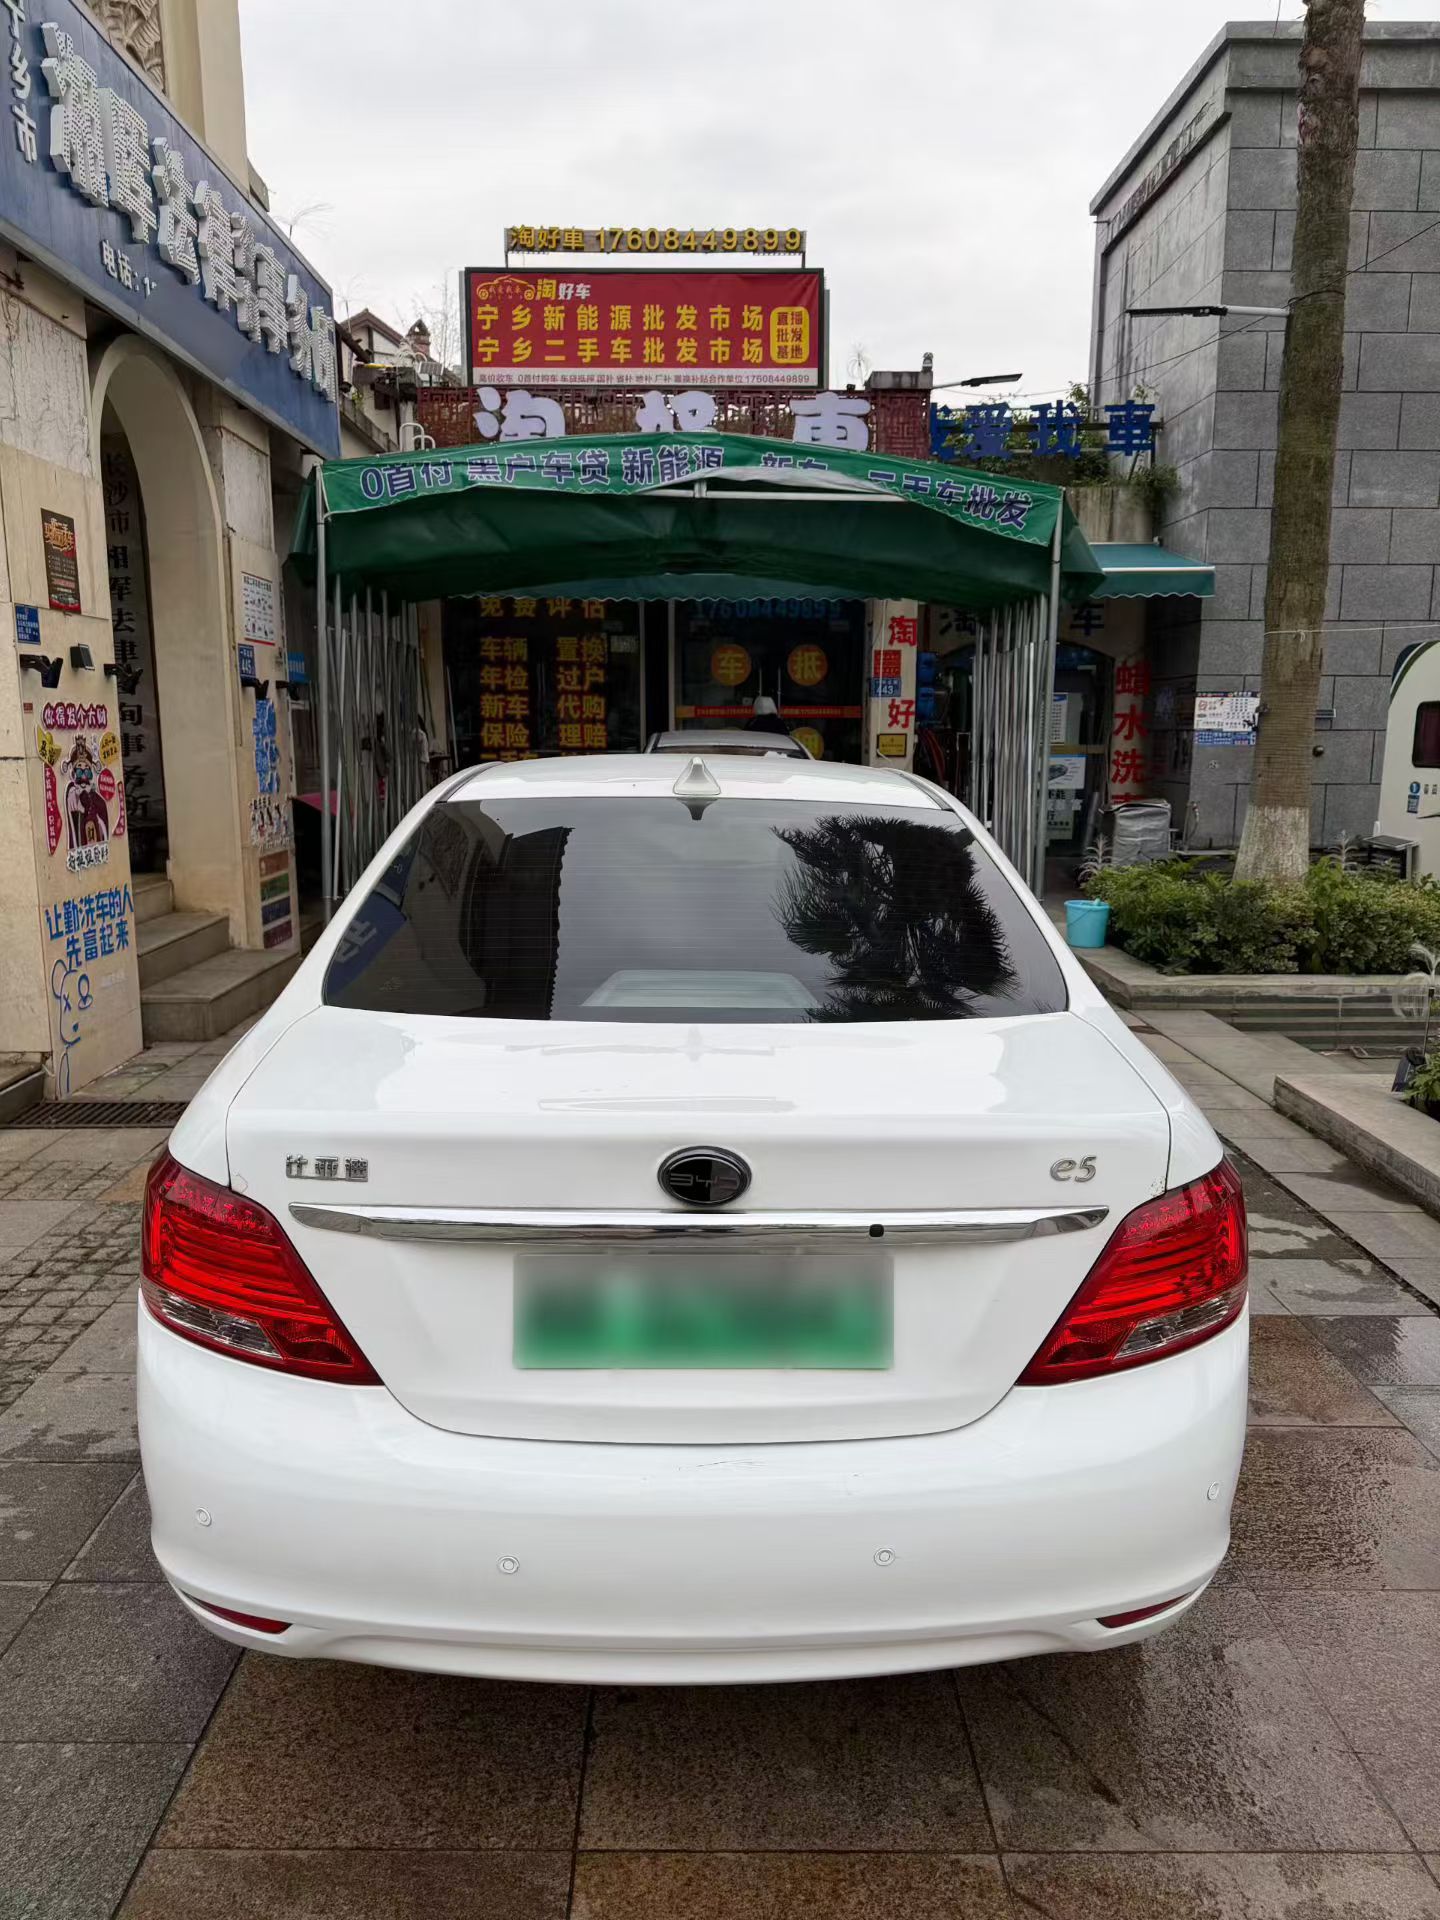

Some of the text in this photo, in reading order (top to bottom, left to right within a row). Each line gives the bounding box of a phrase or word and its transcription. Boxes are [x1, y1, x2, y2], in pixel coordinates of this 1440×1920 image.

[510, 225, 801, 251] 淘好車 17608449899
[536, 279, 591, 300] 淘好车
[477, 304, 764, 331] 宁乡新能源批发市场
[477, 337, 764, 364] 宁乡二手车批发市场
[745, 374, 810, 384] 17608449899
[360, 459, 453, 500] 0首付
[467, 450, 609, 486] 黑户车贷
[621, 444, 724, 484] 新能源
[480, 598, 605, 618] 免费评估
[481, 635, 607, 663] 车辆 置换
[481, 666, 605, 691] 年检 过户
[717, 651, 821, 680] 车 抵
[875, 684, 894, 695] 443
[44, 703, 107, 728] 你得发个大财
[480, 695, 605, 719] 新车 代购
[481, 723, 607, 748] 保险 理赔
[1111, 658, 1150, 804] 蜡水洗
[45, 883, 134, 940] 让勤洗车的人
[66, 918, 129, 971] 先富起来
[286, 1154, 368, 1182] 比亚迪
[1049, 1156, 1096, 1182] e5
